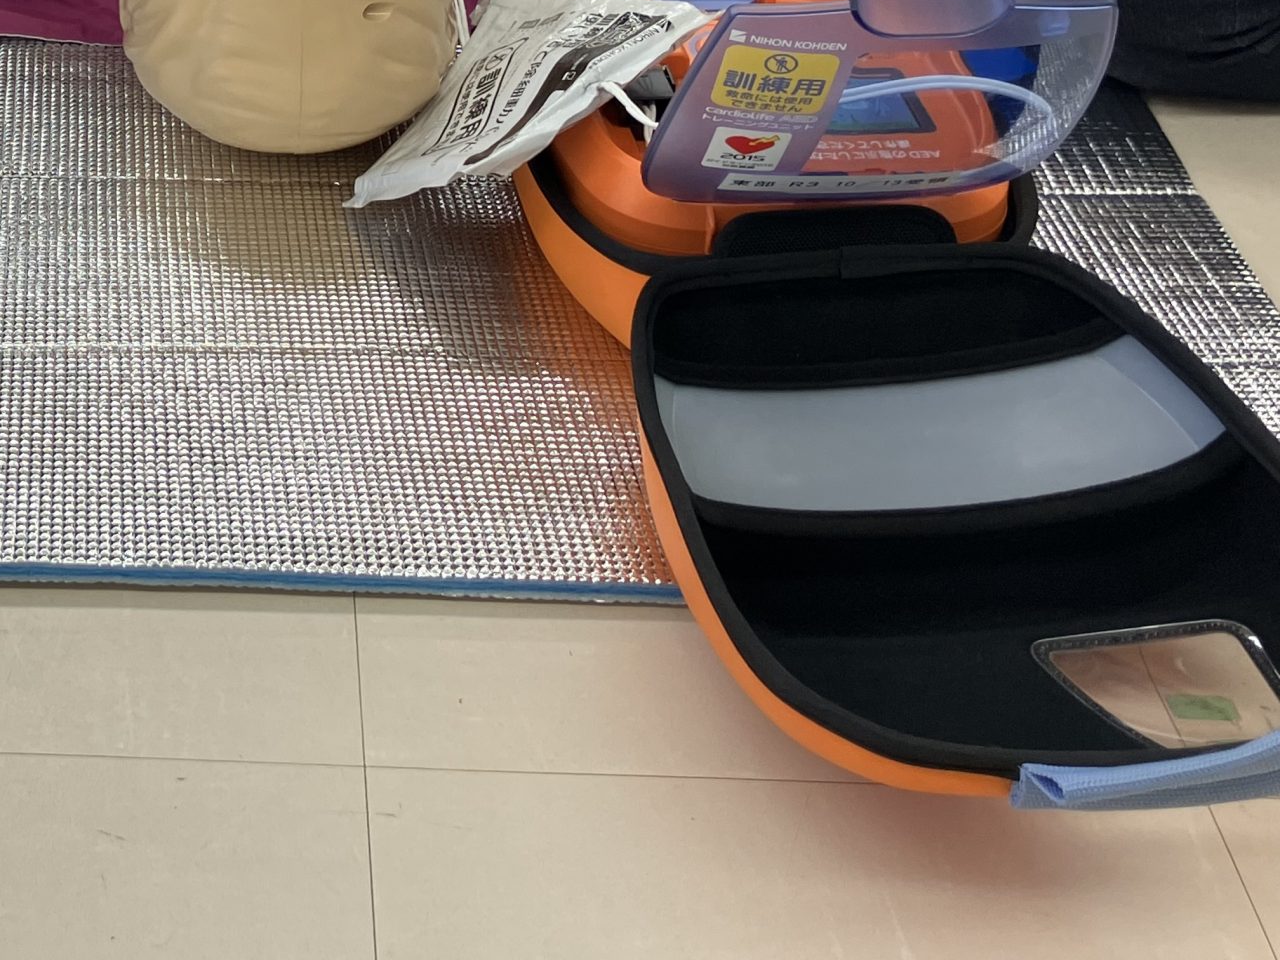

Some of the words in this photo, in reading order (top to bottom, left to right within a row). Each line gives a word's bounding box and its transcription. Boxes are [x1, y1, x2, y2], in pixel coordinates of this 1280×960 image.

[749, 34, 792, 46] NIHON
[794, 41, 848, 51] KOHDEN
[723, 69, 827, 97] 訓練用
[725, 90, 813, 106] 救命には使用
[731, 99, 803, 113] できません
[720, 152, 767, 162] 2015
